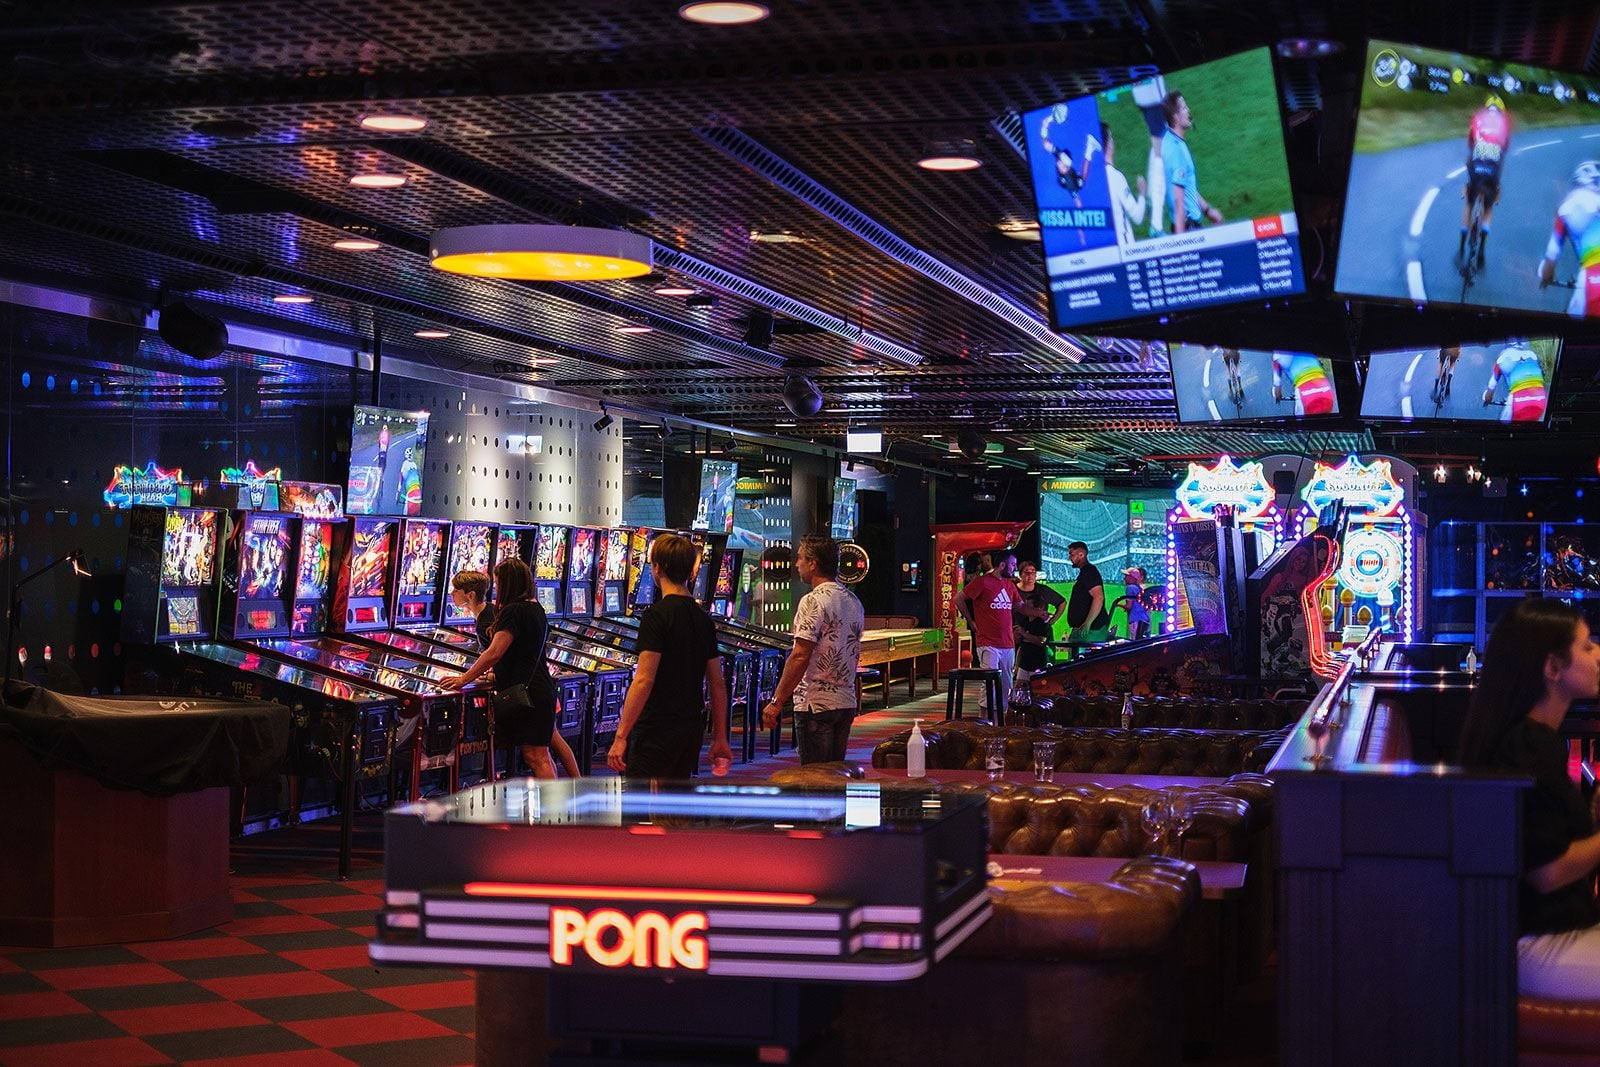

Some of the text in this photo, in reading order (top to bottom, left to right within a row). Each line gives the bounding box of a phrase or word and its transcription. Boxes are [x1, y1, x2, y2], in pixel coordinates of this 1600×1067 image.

[1051, 481, 1096, 489] MINIGOLF
[990, 601, 1013, 609] adida
[231, 680, 254, 695] THE
[550, 905, 709, 969] PONG
